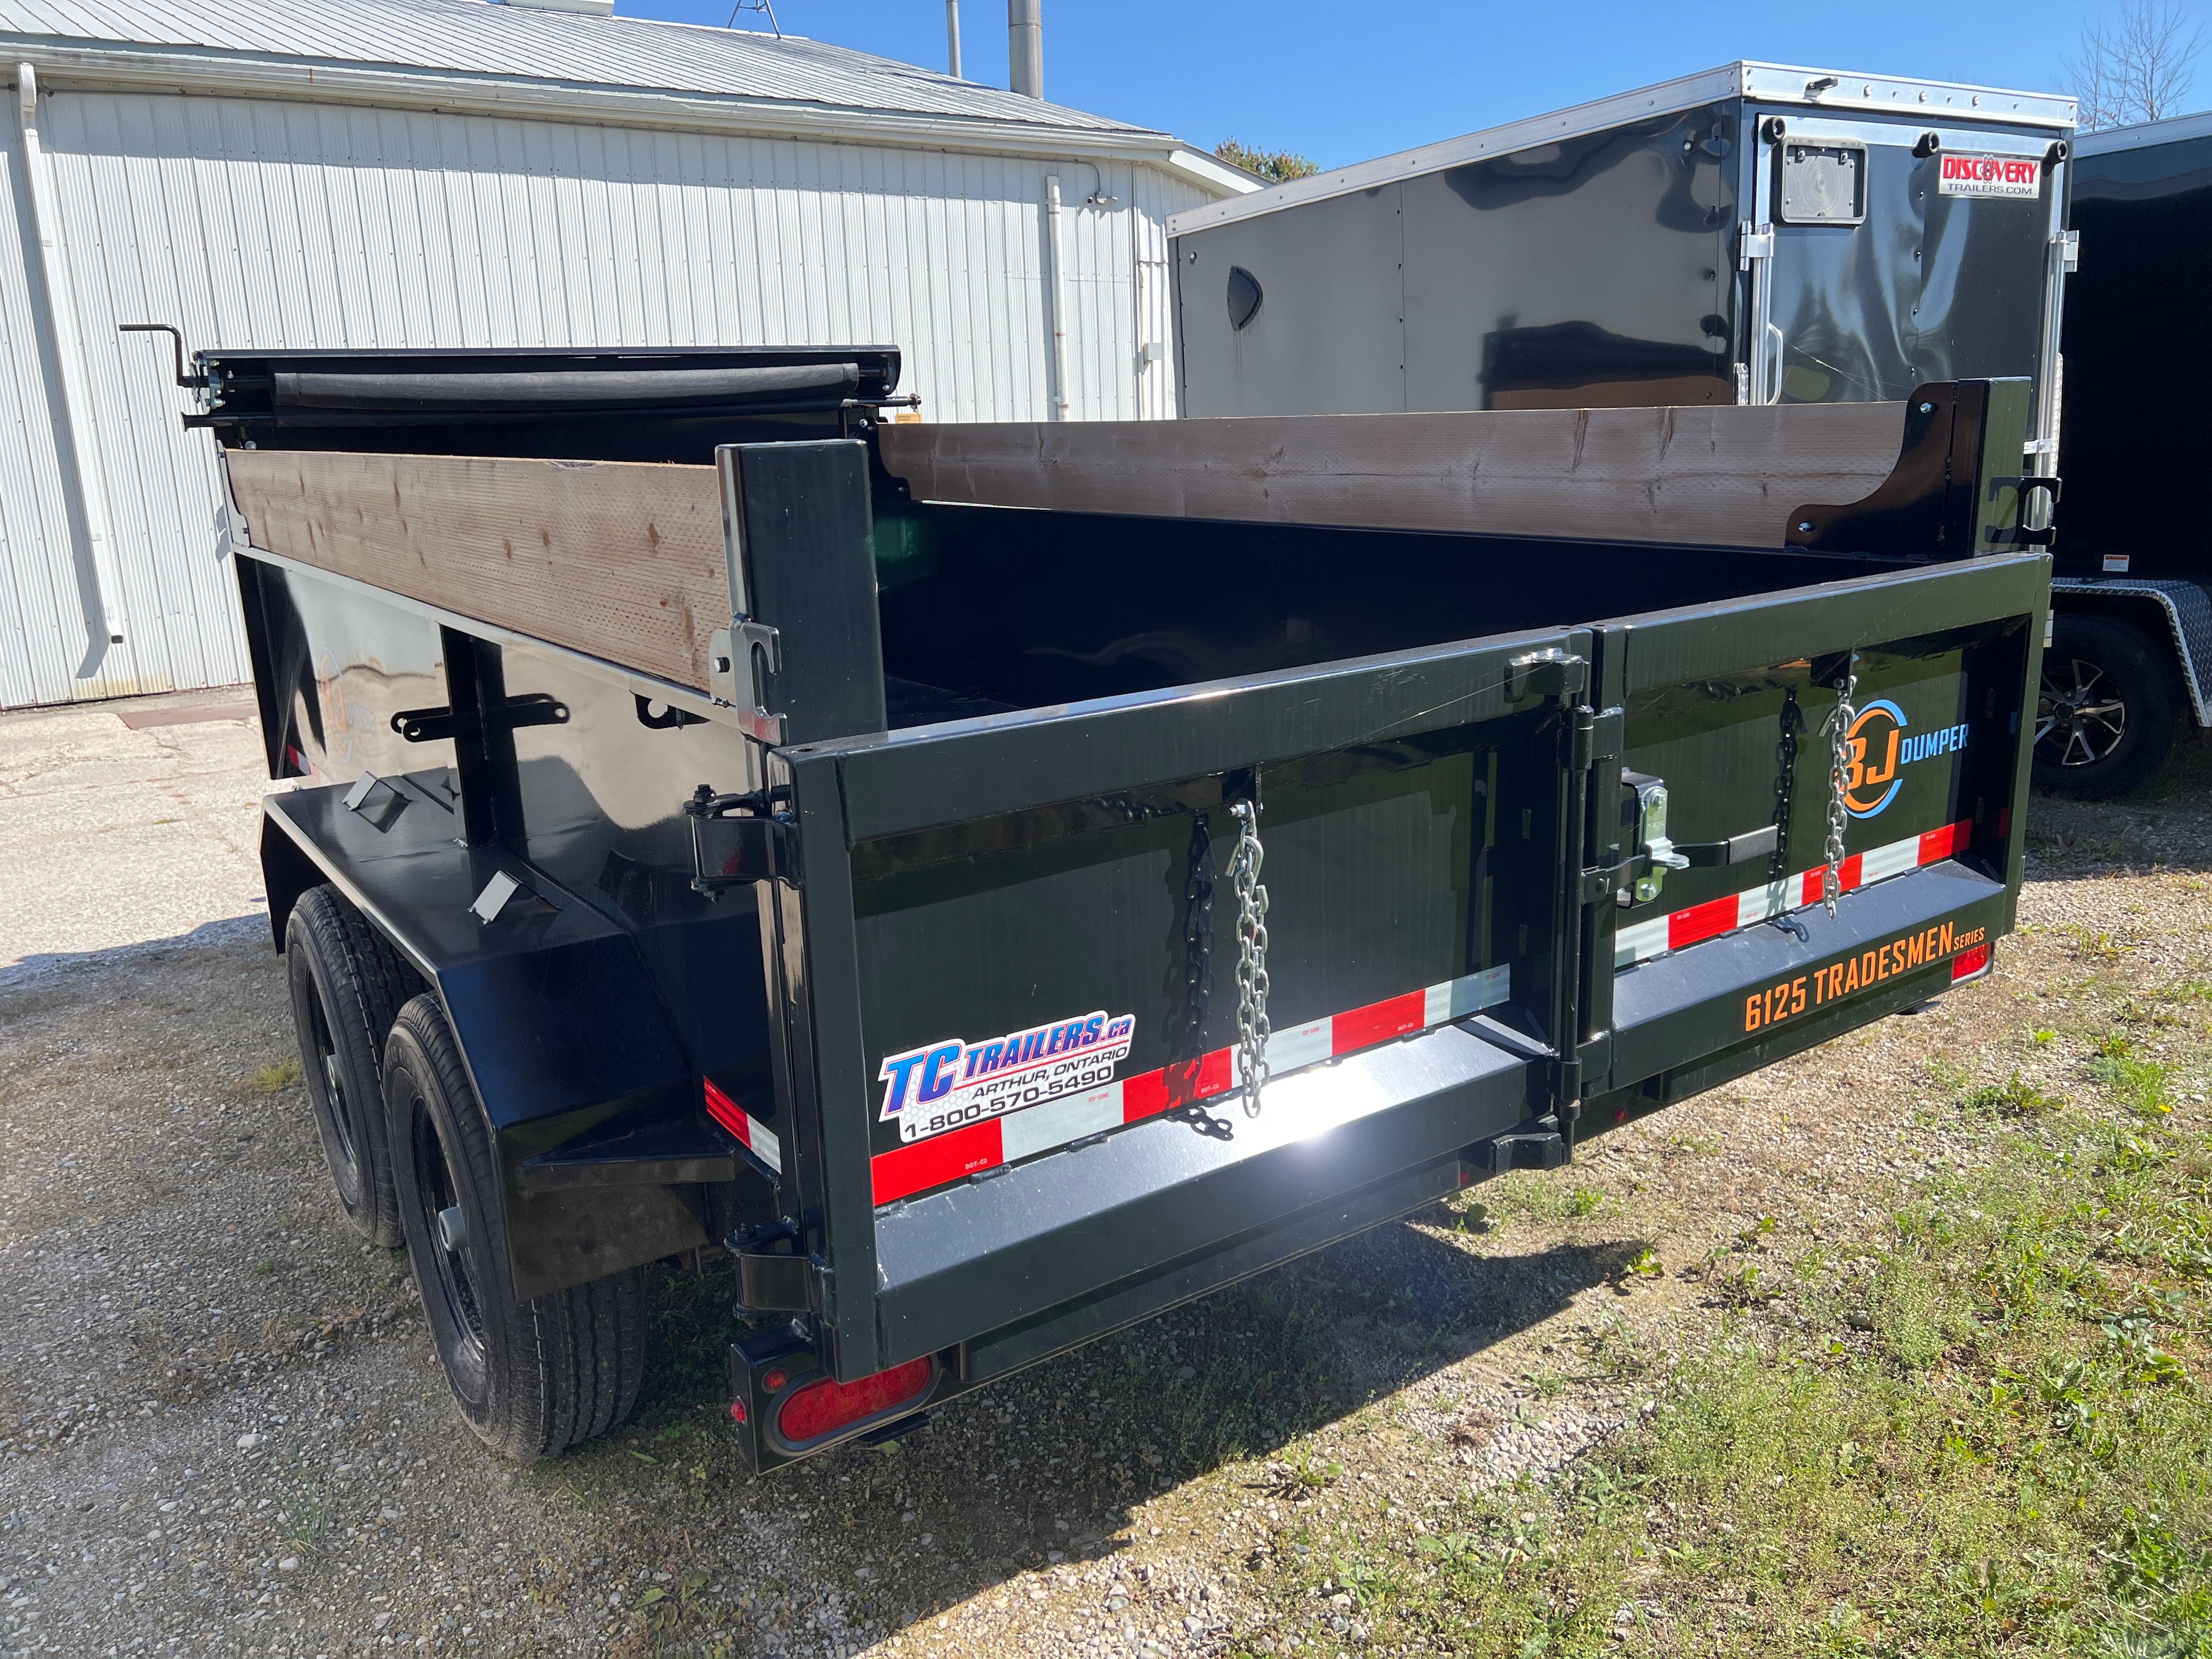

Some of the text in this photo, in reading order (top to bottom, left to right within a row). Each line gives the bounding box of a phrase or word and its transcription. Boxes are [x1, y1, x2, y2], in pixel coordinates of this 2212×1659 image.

[1943, 156, 2038, 183] DISCOVERY
[1948, 183, 2032, 195] TRAILERS.COM
[1901, 724, 1968, 764] DUMPER
[1745, 921, 1985, 1032] 6125 TRADESMEN SERIES
[885, 1014, 1132, 1115] TC TRAILERS.ca
[971, 1046, 1128, 1100] ARTHUR, ONTARIO
[905, 1065, 1112, 1138] 1-800-570-5490
[965, 1158, 987, 1170] DOT-C2
